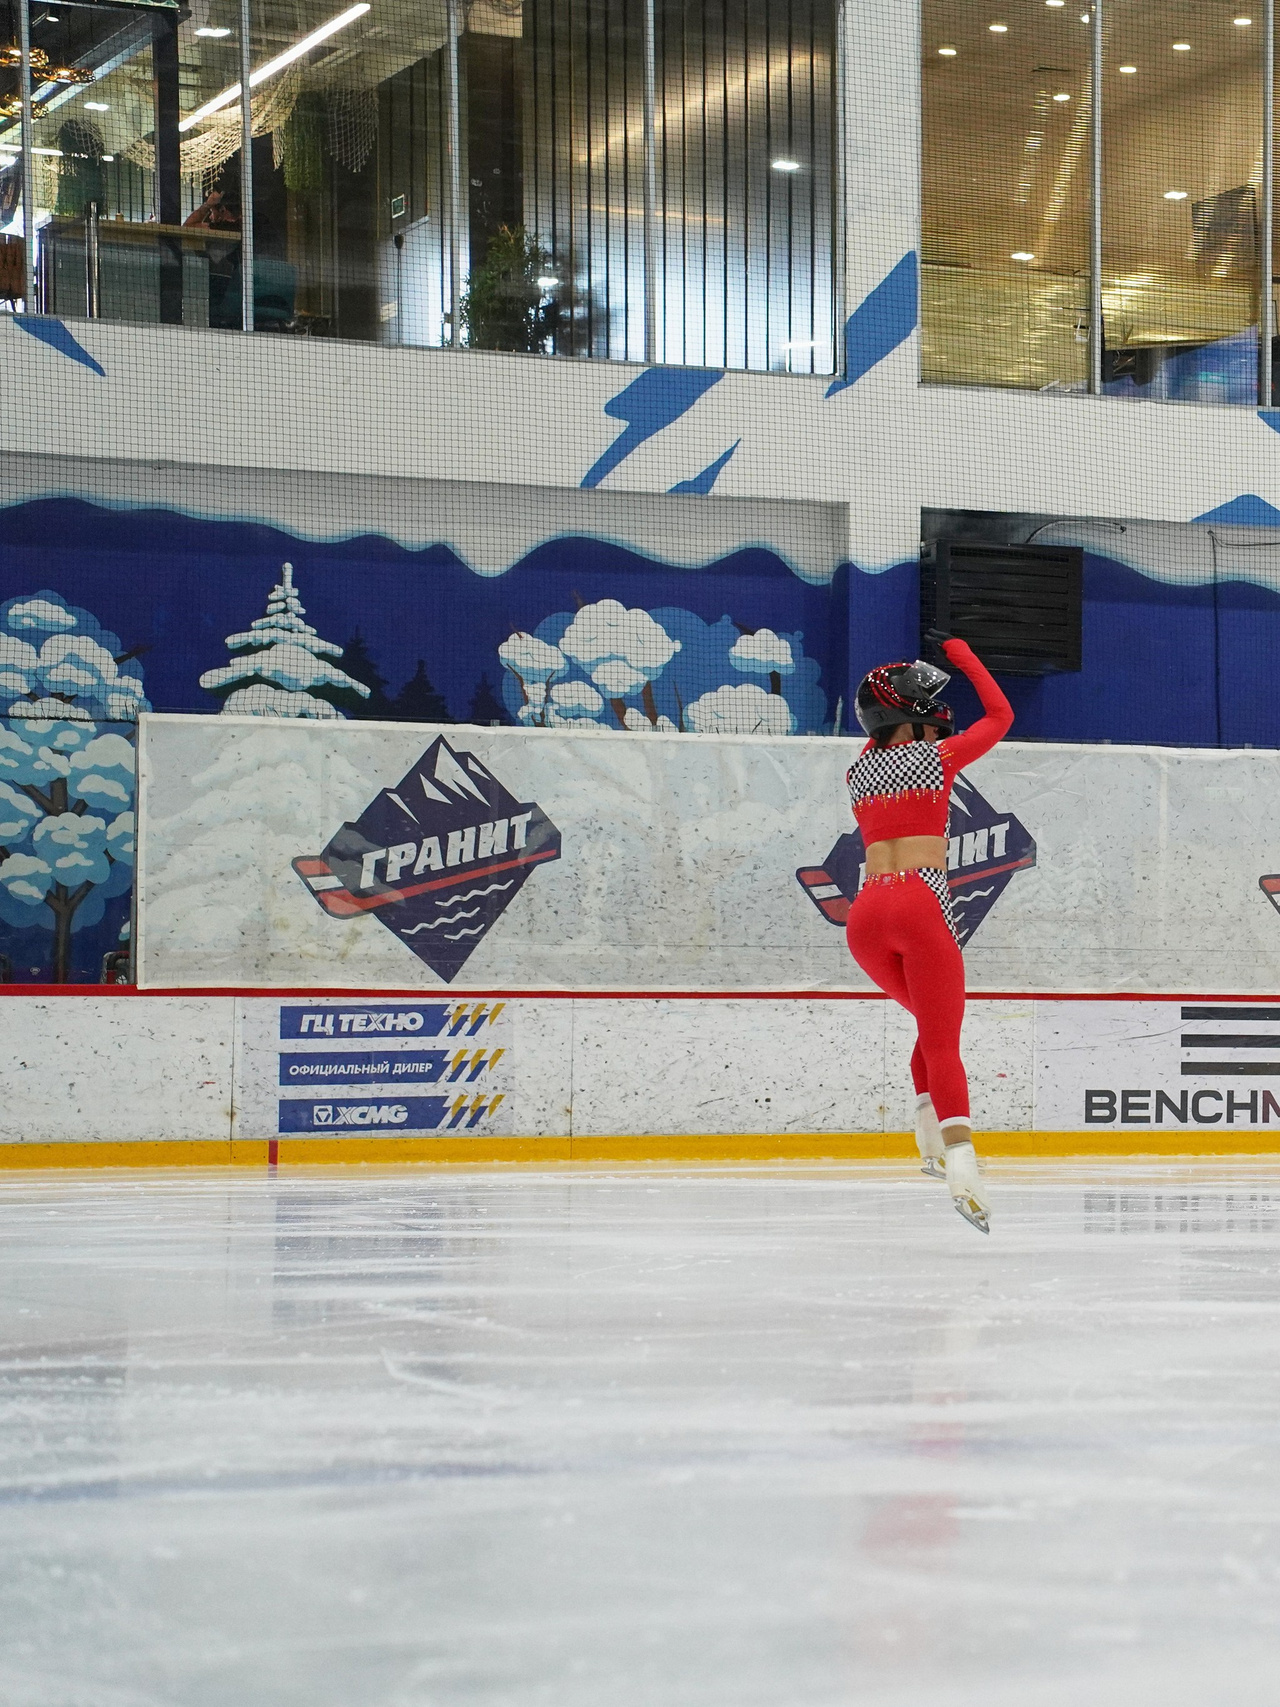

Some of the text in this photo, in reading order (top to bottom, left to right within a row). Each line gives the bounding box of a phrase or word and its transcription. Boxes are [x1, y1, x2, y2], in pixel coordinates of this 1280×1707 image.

[360, 811, 532, 888] ГРАНИТ
[300, 1012, 424, 1036] ГЦ ТЕХНО
[289, 1060, 433, 1077] ОФИЦИАЛЬНЫЙ ДИЛЕР
[333, 1105, 409, 1126] XCMG
